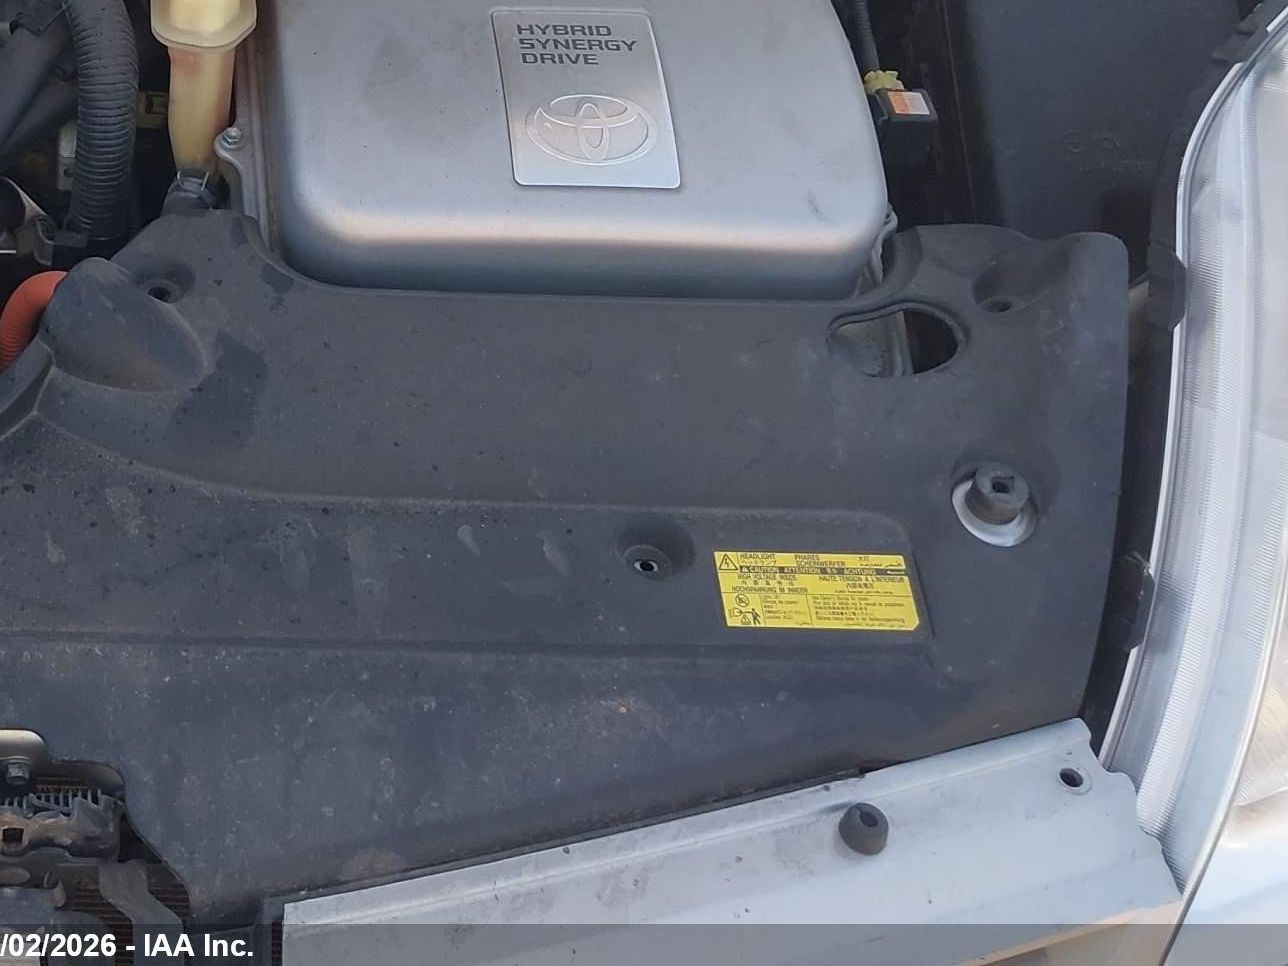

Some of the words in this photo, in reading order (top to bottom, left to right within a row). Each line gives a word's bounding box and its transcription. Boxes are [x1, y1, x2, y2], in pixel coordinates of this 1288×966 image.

[516, 24, 612, 36] HYBRID
[518, 38, 638, 51] SYNERGY
[521, 52, 600, 65] DRIVE
